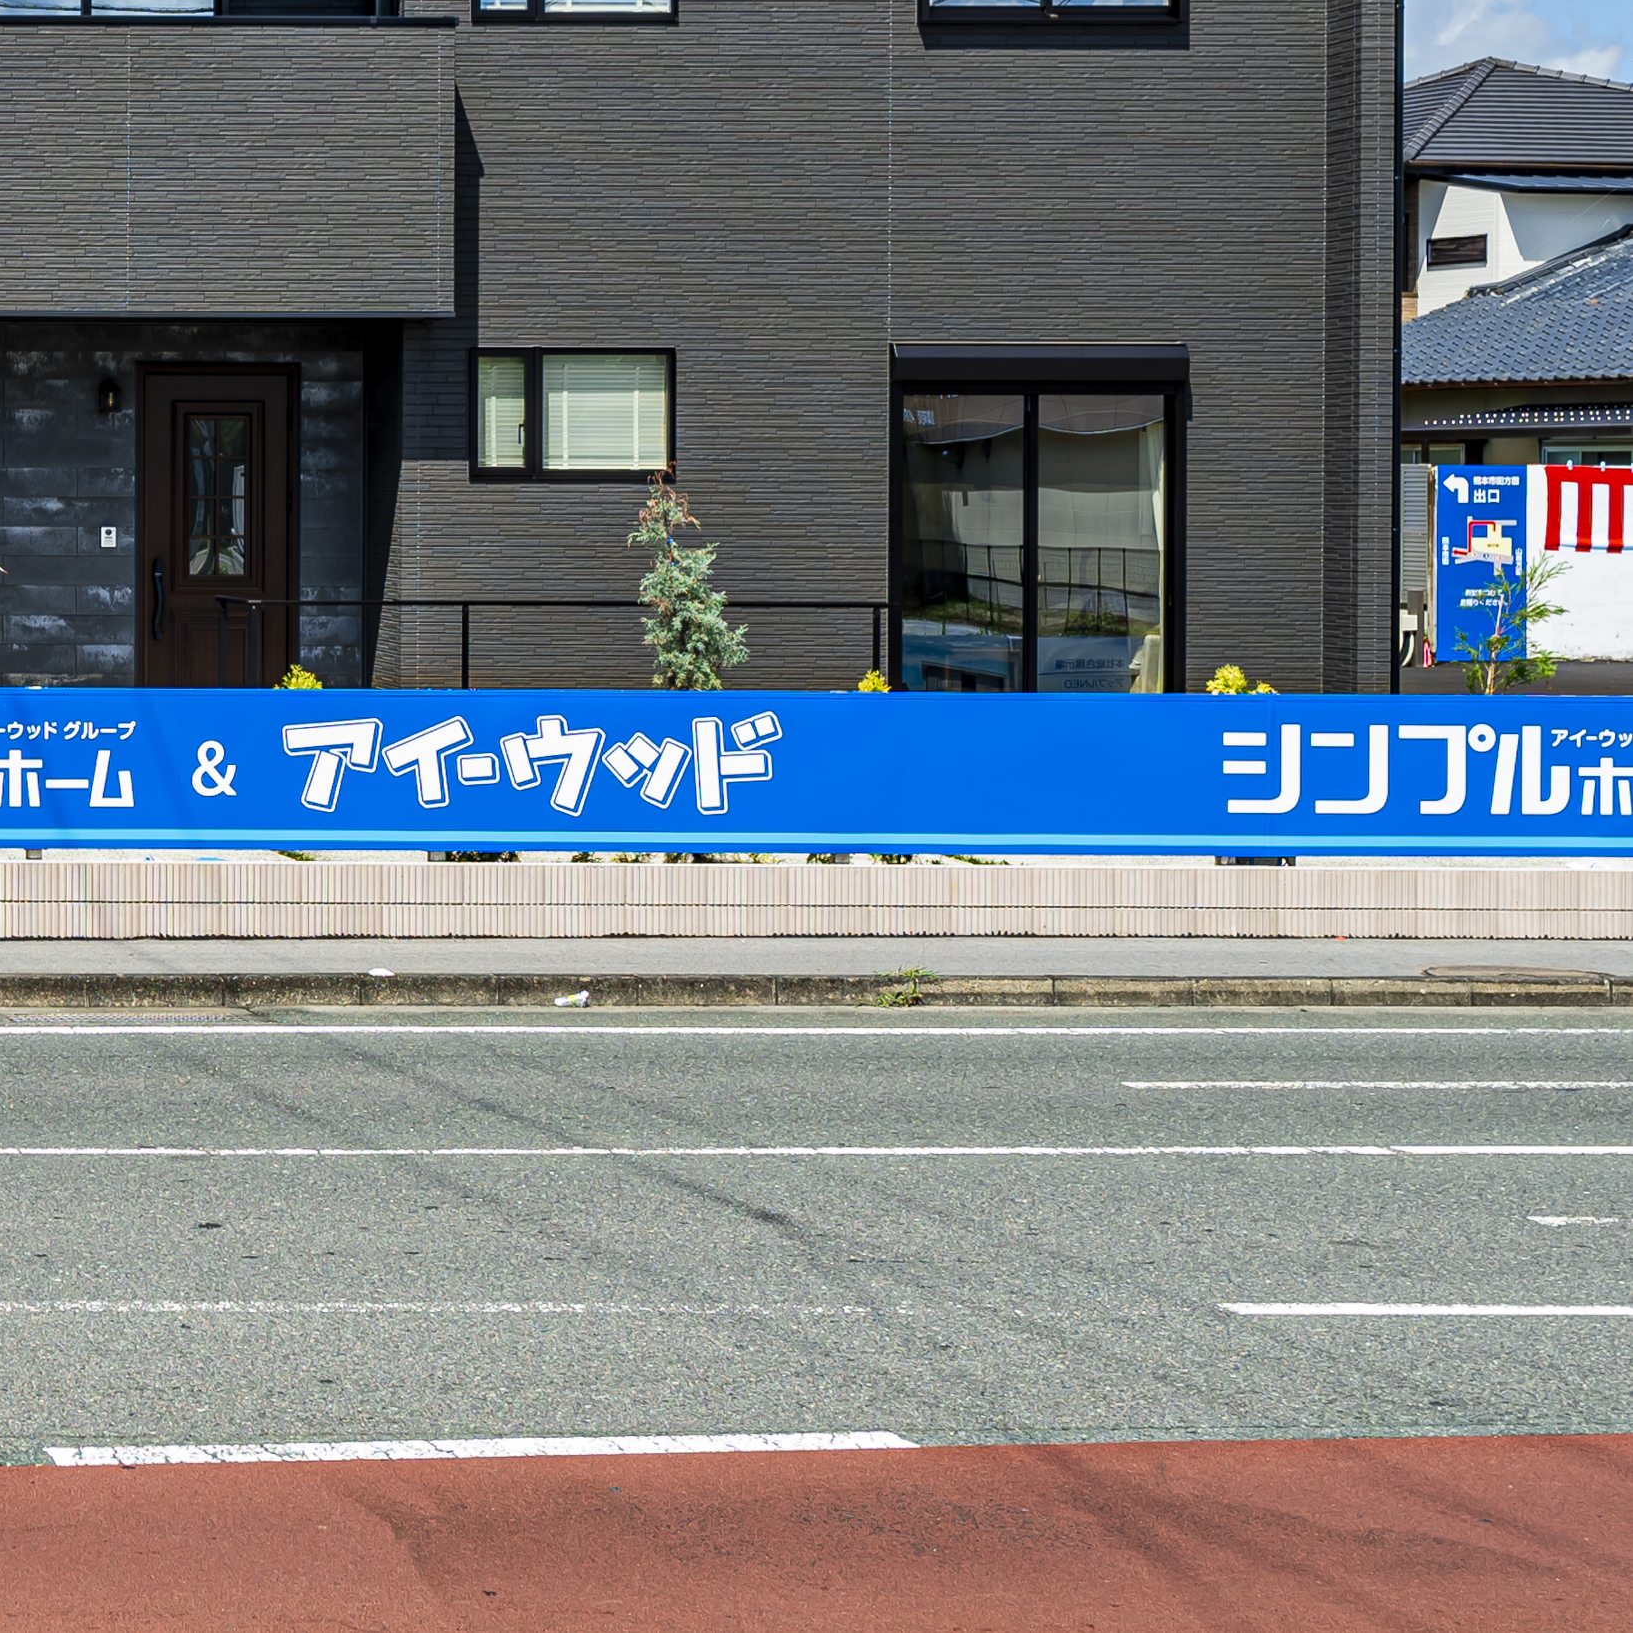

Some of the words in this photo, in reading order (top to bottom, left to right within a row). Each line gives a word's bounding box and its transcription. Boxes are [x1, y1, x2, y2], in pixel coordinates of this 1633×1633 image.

[1474, 488, 1500, 503] 出口
[63, 720, 137, 740] グループ
[191, 740, 237, 797] &
